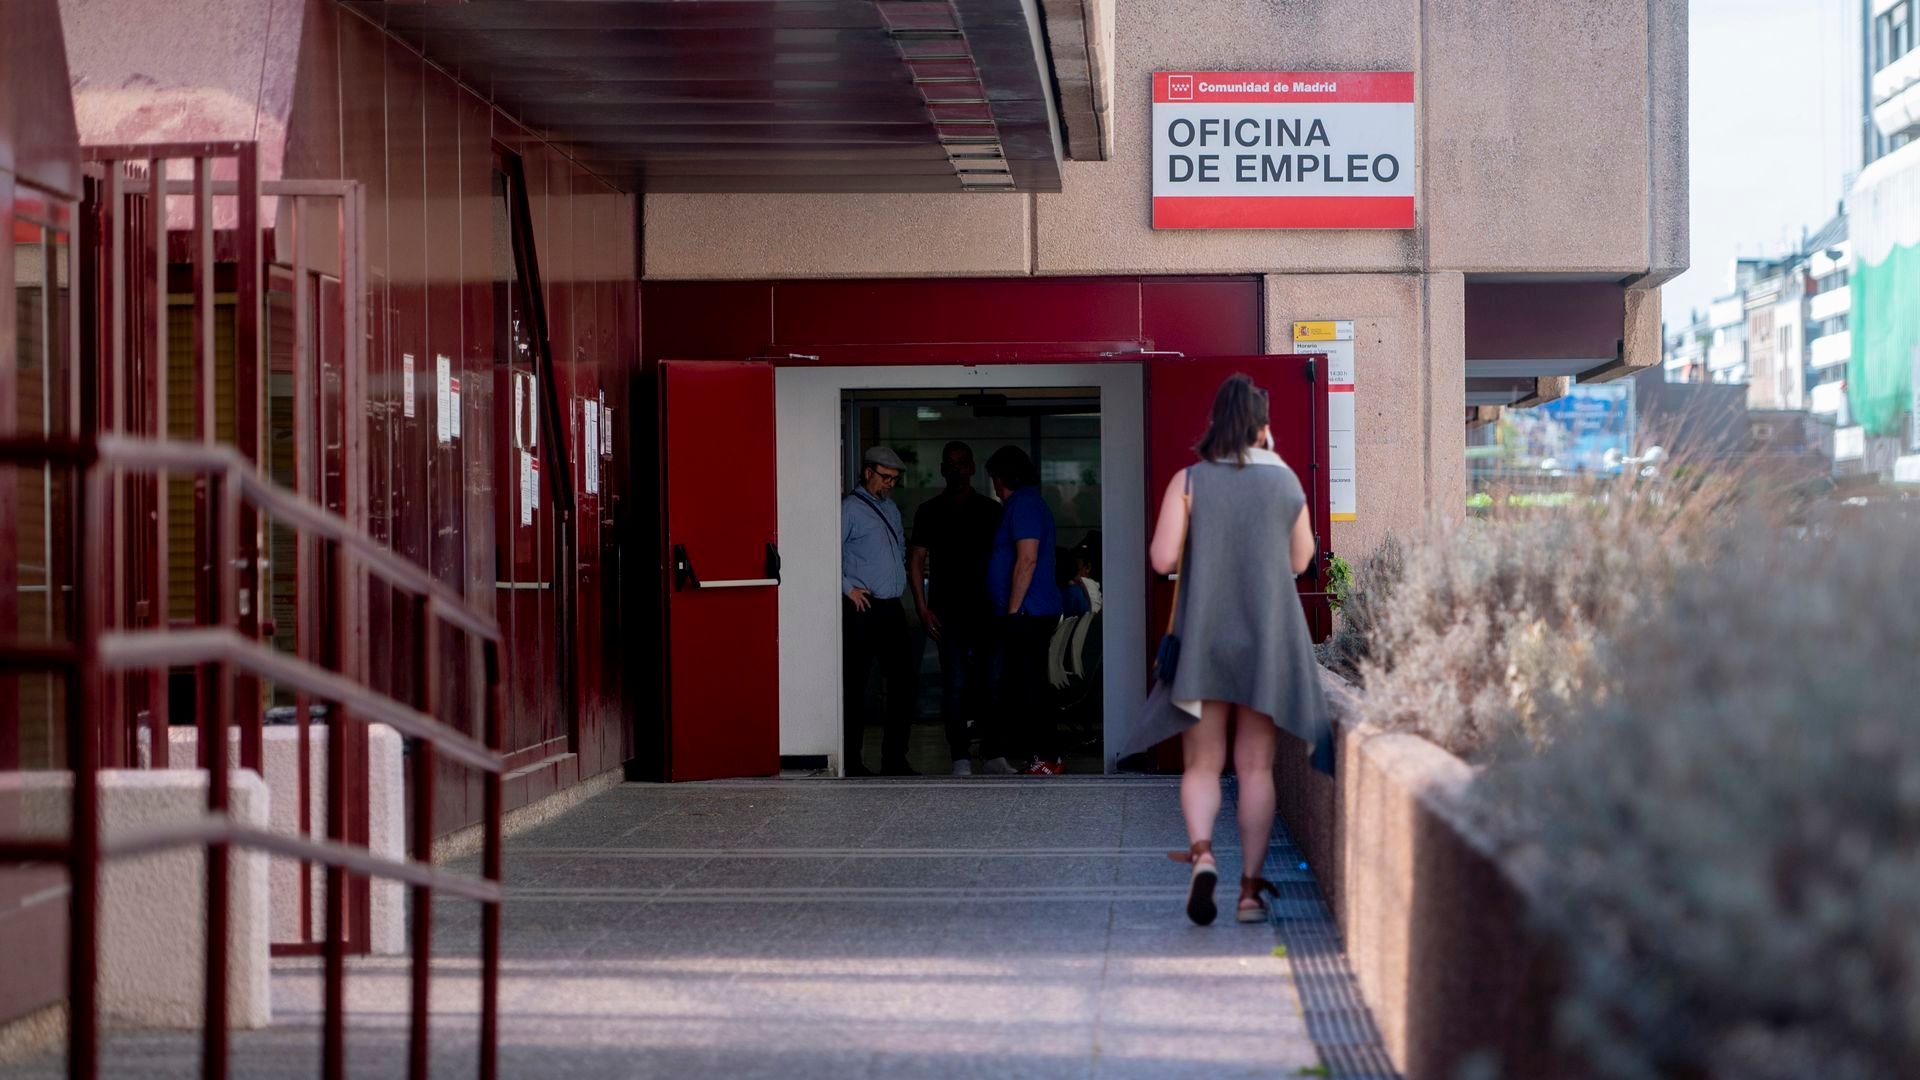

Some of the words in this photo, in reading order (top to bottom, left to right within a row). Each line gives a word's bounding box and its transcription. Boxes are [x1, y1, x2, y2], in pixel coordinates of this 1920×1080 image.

[1198, 82, 1270, 93] Comunidad
[1273, 82, 1289, 93] de
[1293, 82, 1337, 93] Madrid
[1168, 118, 1331, 147] OFICINA
[1169, 154, 1220, 182] DE
[1236, 153, 1400, 183] EMPLEO
